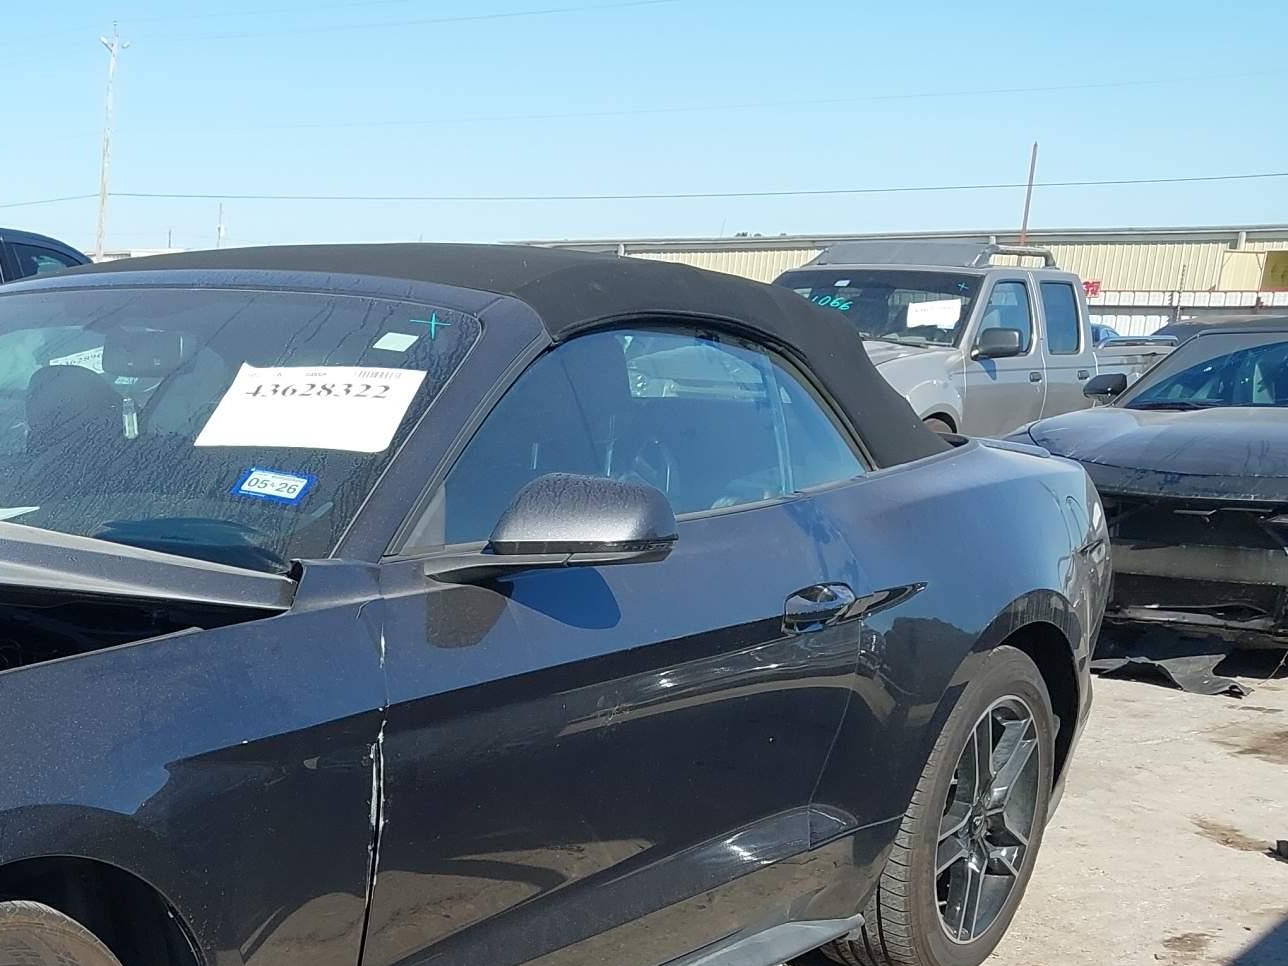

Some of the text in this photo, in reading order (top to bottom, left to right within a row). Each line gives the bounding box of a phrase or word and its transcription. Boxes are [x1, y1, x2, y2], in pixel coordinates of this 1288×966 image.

[245, 383, 391, 399] 43628322
[247, 477, 269, 489] 05
[275, 482, 300, 494] 26
